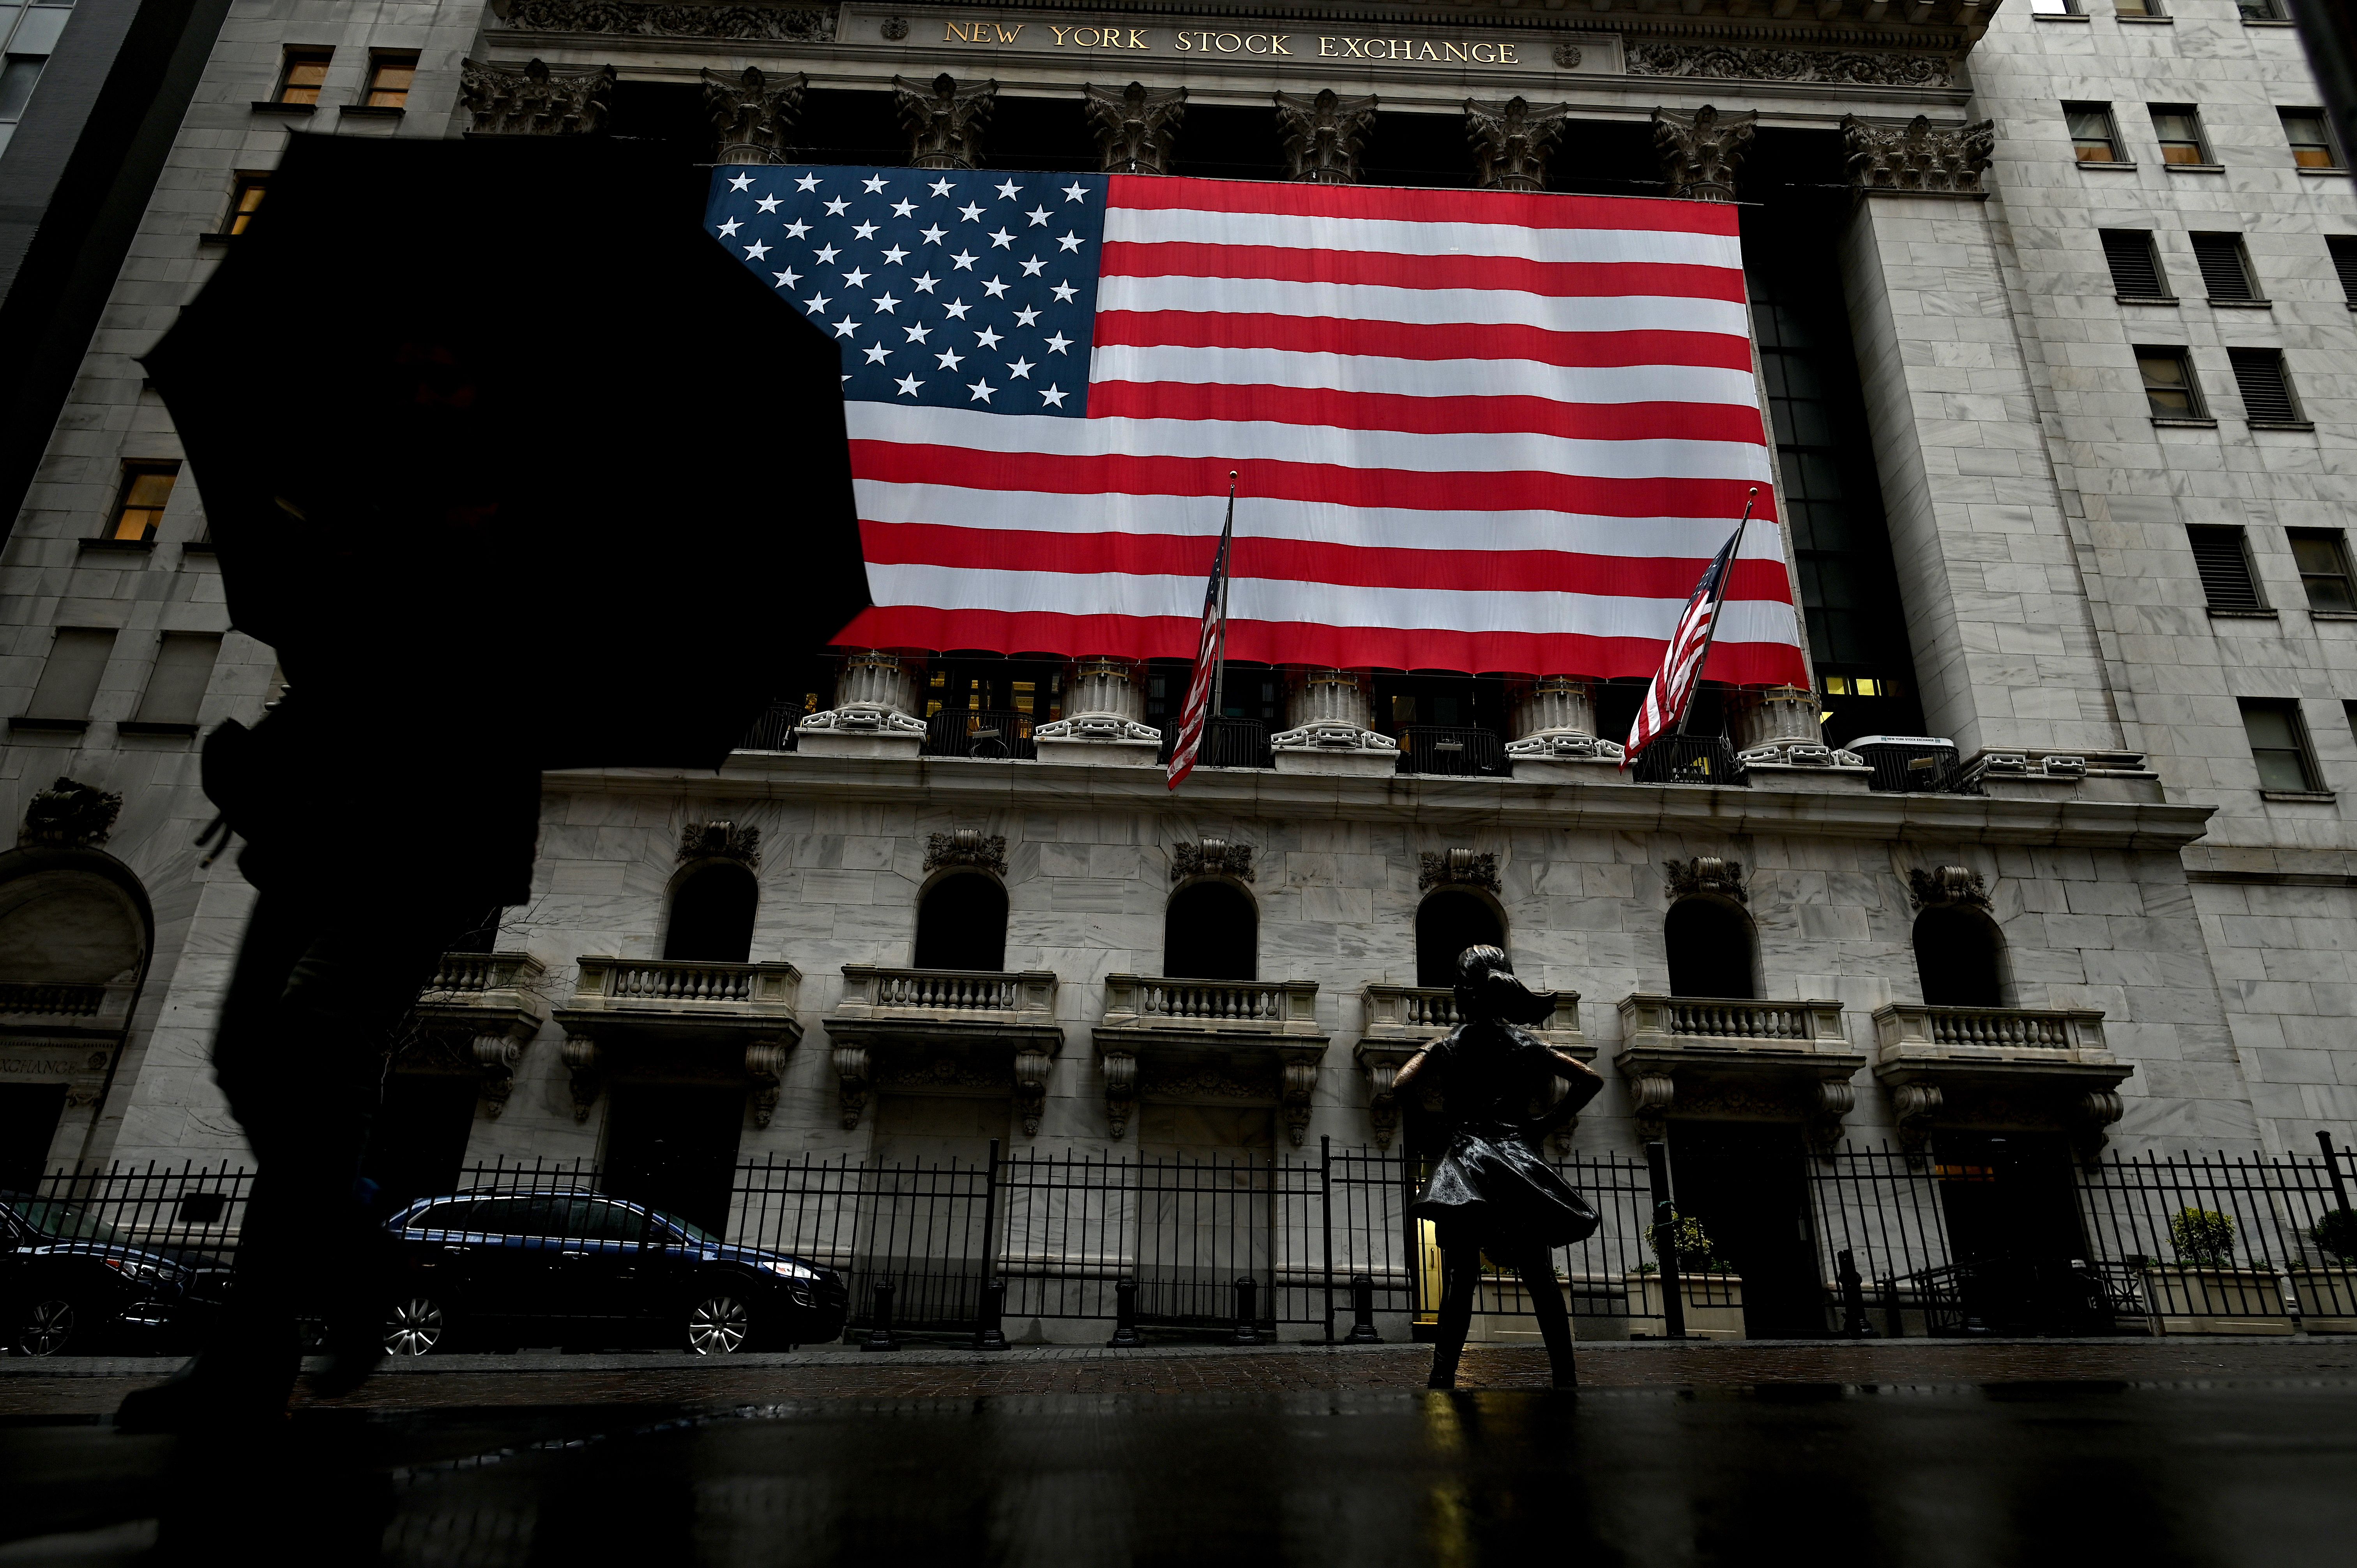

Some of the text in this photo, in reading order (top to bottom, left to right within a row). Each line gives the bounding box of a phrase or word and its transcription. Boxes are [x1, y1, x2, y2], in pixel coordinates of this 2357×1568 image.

[943, 22, 1519, 64] NEW YORK STOCK EXCHANGE
[0, 1059, 78, 1074] XCHANGE
